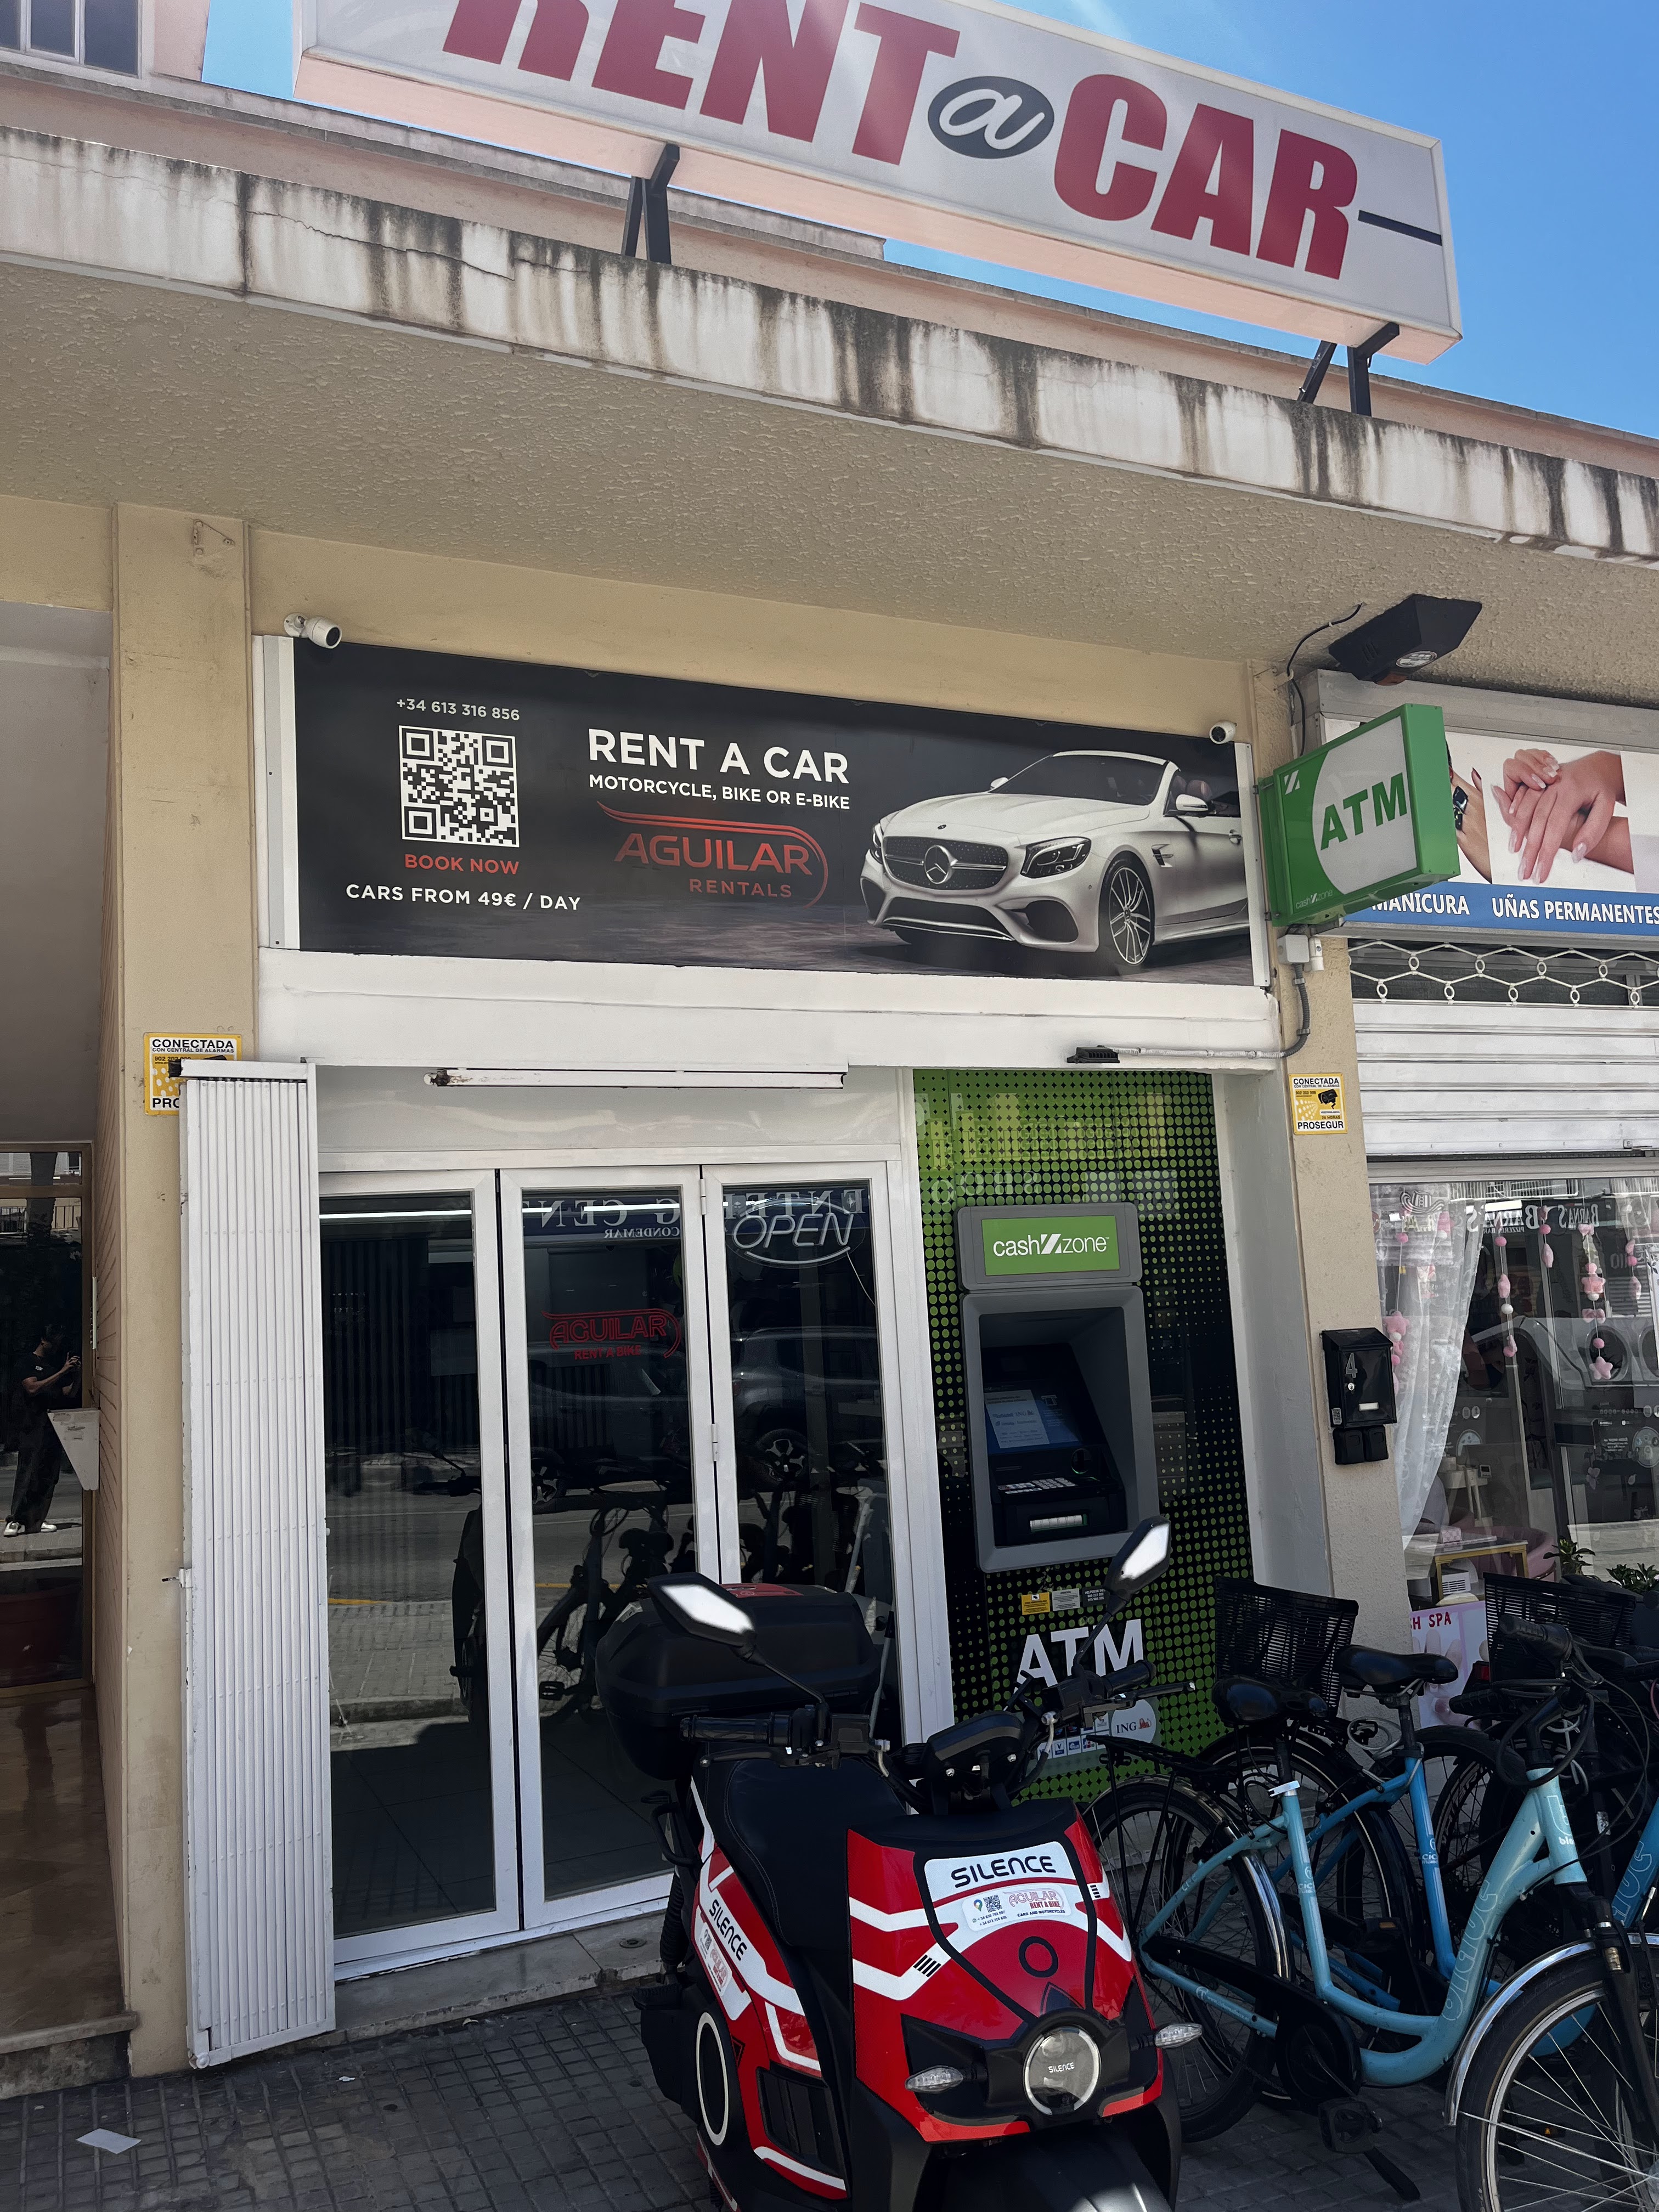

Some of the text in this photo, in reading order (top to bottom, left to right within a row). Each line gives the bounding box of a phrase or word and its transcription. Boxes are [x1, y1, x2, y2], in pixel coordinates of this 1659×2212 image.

[1053, 74, 1359, 280] CAR
[397, 698, 520, 721] +34 613 316 856
[588, 728, 850, 784] RENT A CAR
[589, 774, 850, 810] MOTORCYCLE, BIKE OR E-BIKE
[1321, 772, 1407, 851] ATM
[405, 854, 520, 875] BOOK NOW
[614, 832, 812, 876] AGUILAR
[346, 884, 403, 900] CARS
[411, 888, 470, 904] FROM
[478, 893, 516, 907] 49€
[540, 895, 581, 910] DAY
[690, 878, 792, 898] RENTALS
[1372, 893, 1659, 924] MANICURA UÑAS PERMANENTES
[152, 1039, 234, 1049] CONECTADA
[1297, 1121, 1344, 1130] PROSEGUR
[732, 1214, 854, 1248] OPEN
[993, 1235, 1107, 1257] cash zone
[549, 1316, 666, 1350] AGUILAR
[574, 1345, 641, 1360] RENT A BIKE
[1346, 1352, 1358, 1379] 4
[1429, 1612, 1452, 1628] SPA
[1014, 1619, 1144, 1695] ATM
[1116, 1722, 1137, 1734] ING
[951, 1856, 1057, 1888] SILENCE
[709, 1899, 747, 1961] SILENCE
[1048, 2062, 1075, 2074] SILENCE
